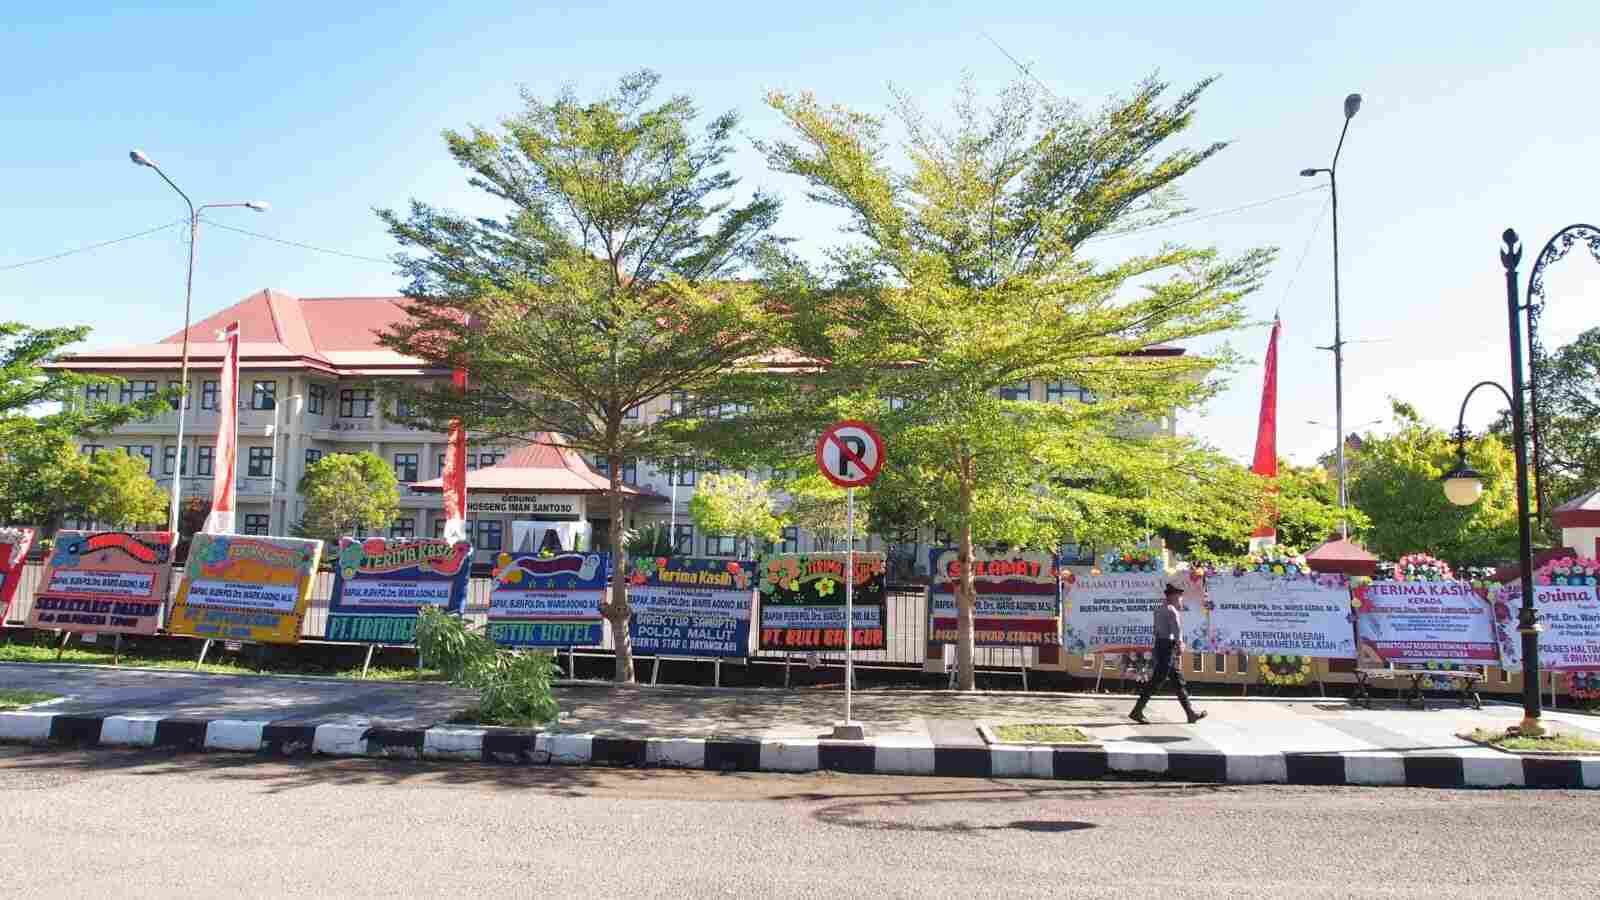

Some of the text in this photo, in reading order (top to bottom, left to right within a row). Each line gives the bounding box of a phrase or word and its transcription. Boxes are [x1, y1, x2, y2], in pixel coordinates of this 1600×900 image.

[840, 436, 866, 476] P
[508, 504, 530, 512] IMAN
[532, 504, 572, 512] SANTOSO
[367, 548, 416, 568] TERIMA
[948, 560, 1040, 577] SLAMAT
[658, 568, 732, 586] Terima Kasih
[1374, 585, 1425, 595] TERIMA
[540, 624, 592, 640] HOTEL
[638, 626, 736, 640] POLDA MALUT
[824, 629, 882, 646] BAGUN
[1240, 631, 1325, 641] PEMERINTAH DAERAH
